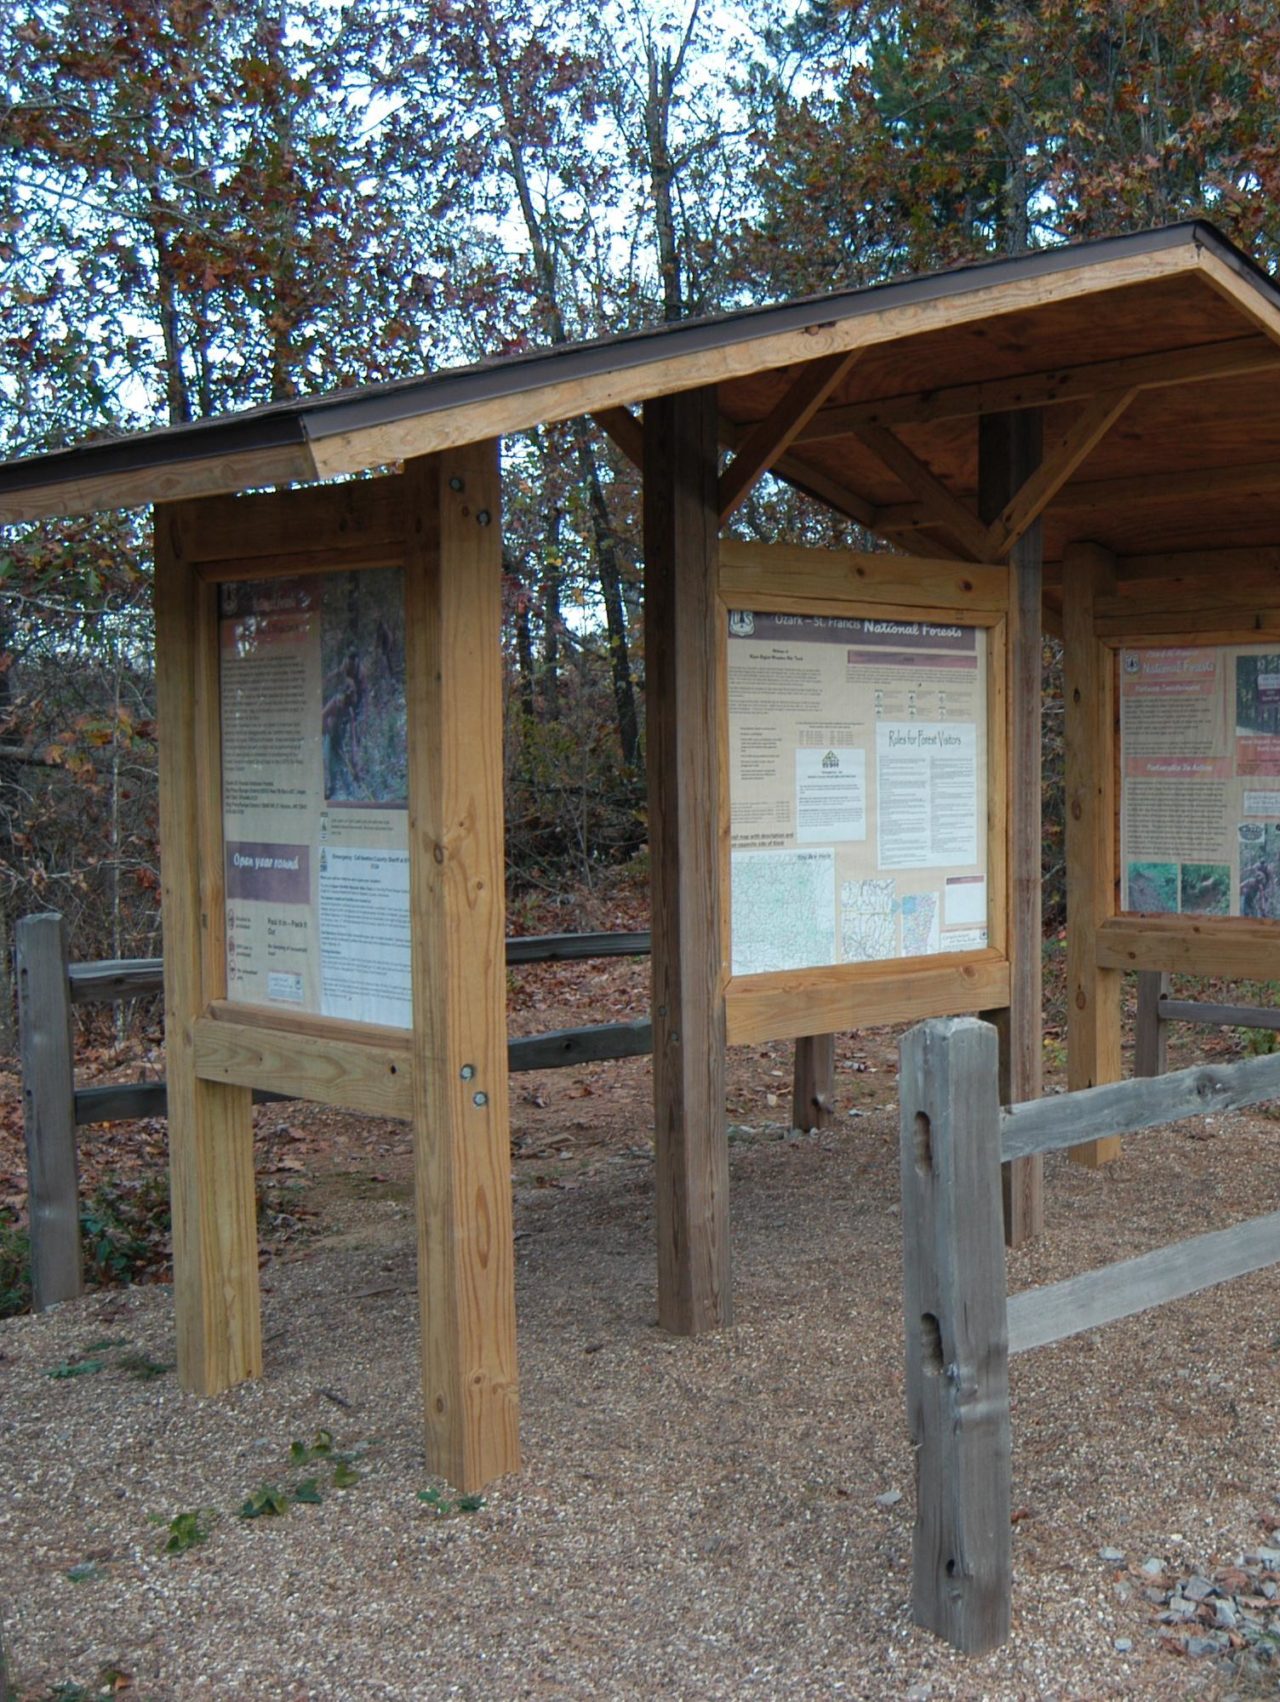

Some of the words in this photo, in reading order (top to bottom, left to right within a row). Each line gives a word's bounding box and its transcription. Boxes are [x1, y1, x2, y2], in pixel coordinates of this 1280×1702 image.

[775, 615, 804, 626] Ozark
[828, 618, 861, 630] Francis
[864, 620, 919, 636] National
[922, 625, 962, 639] Forests
[888, 728, 907, 747] Rules
[907, 729, 917, 745] for
[918, 729, 937, 747] Forest
[937, 730, 962, 748] Visitors
[233, 852, 254, 869] Open
[254, 857, 273, 870] year
[273, 855, 299, 870] round
